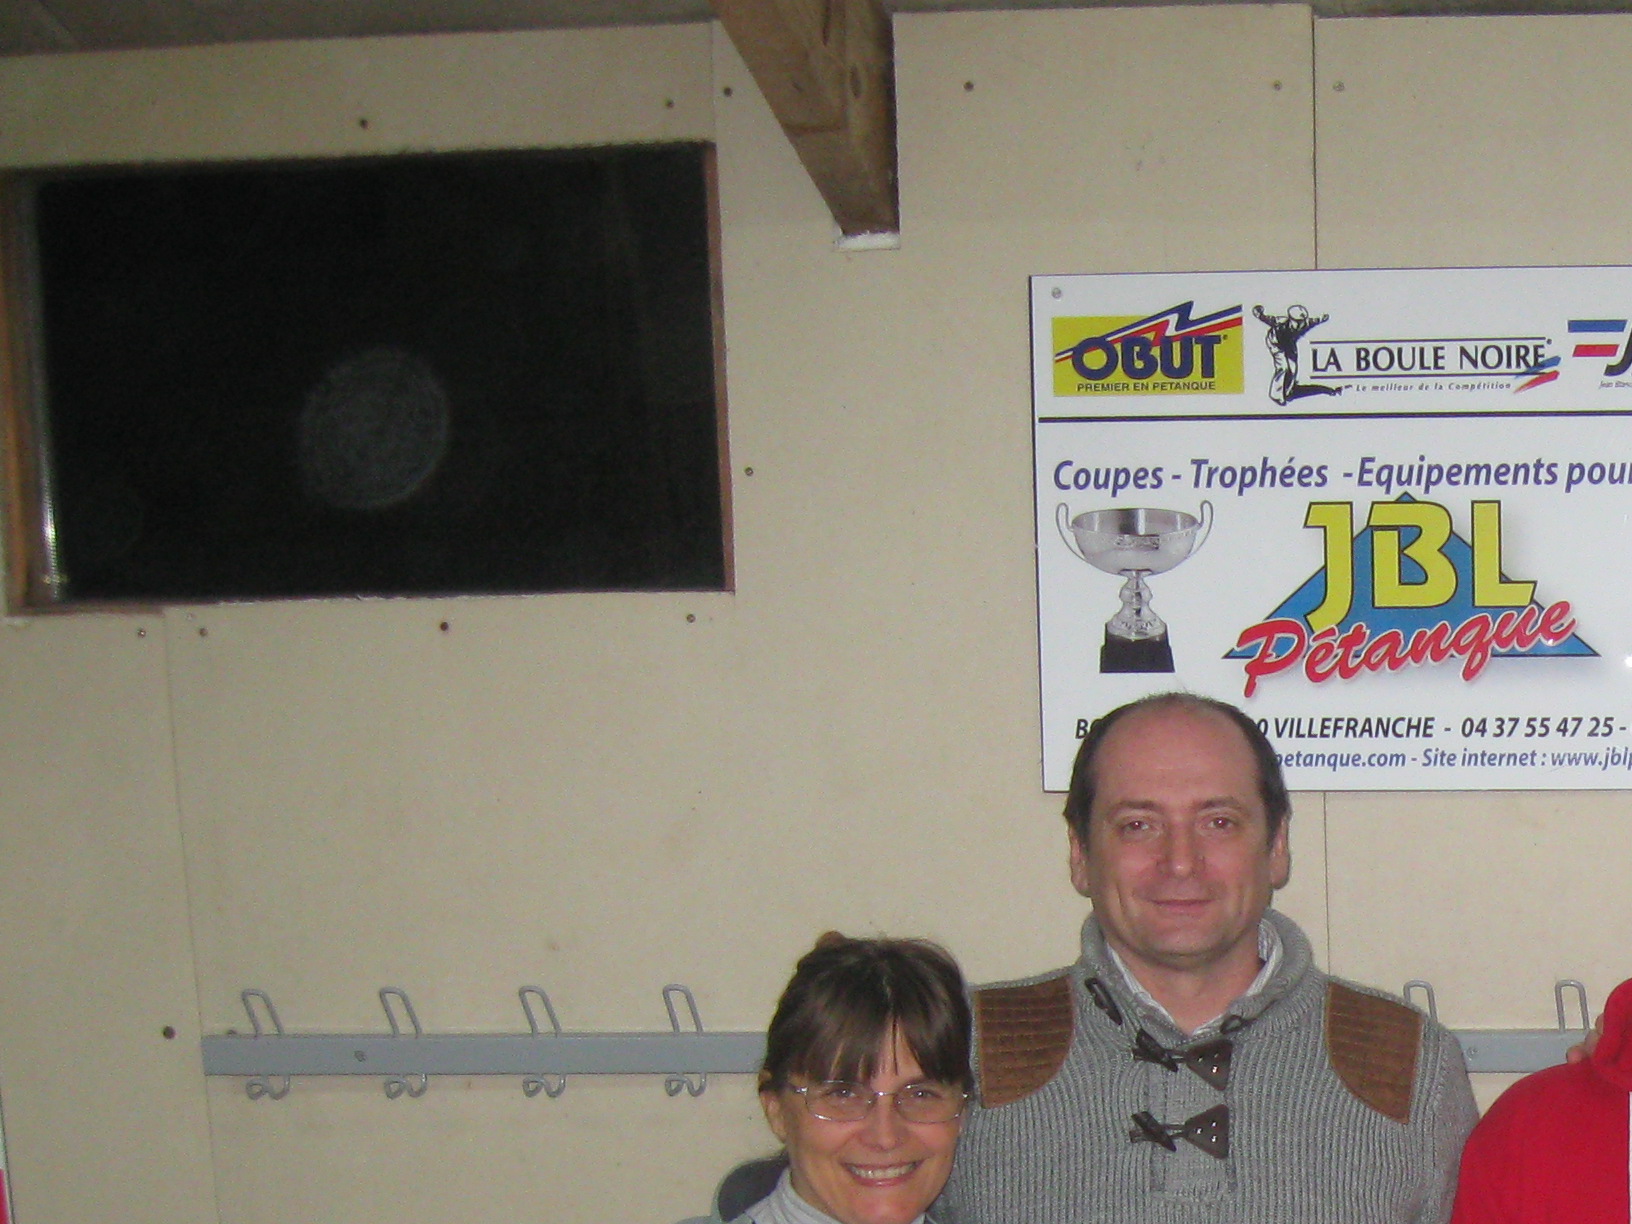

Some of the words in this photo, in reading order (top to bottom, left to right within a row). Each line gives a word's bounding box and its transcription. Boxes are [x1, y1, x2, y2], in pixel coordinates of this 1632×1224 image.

[1072, 334, 1221, 381] OBUT
[1311, 348, 1342, 373] LA
[1354, 345, 1446, 372] BOULE
[1459, 344, 1546, 370] NOIRE
[1077, 382, 1129, 392] PREMIER
[1133, 382, 1149, 391] EN
[1152, 381, 1216, 391] PETANQUE
[1418, 382, 1430, 391] de
[1434, 382, 1444, 391] la
[1053, 459, 1165, 498] Coupes
[1190, 456, 1329, 496] Trophées
[1303, 500, 1538, 633] JBL
[1235, 600, 1577, 699] Pétanque
[1274, 717, 1435, 738] VILLEFRANCHE
[1461, 717, 1488, 738] 04
[1492, 716, 1520, 738] 37
[1524, 716, 1551, 738] 55
[1556, 716, 1583, 738] 47
[1587, 716, 1615, 738] 25
[1422, 748, 1458, 768] Site
[1461, 747, 1538, 768] internet
